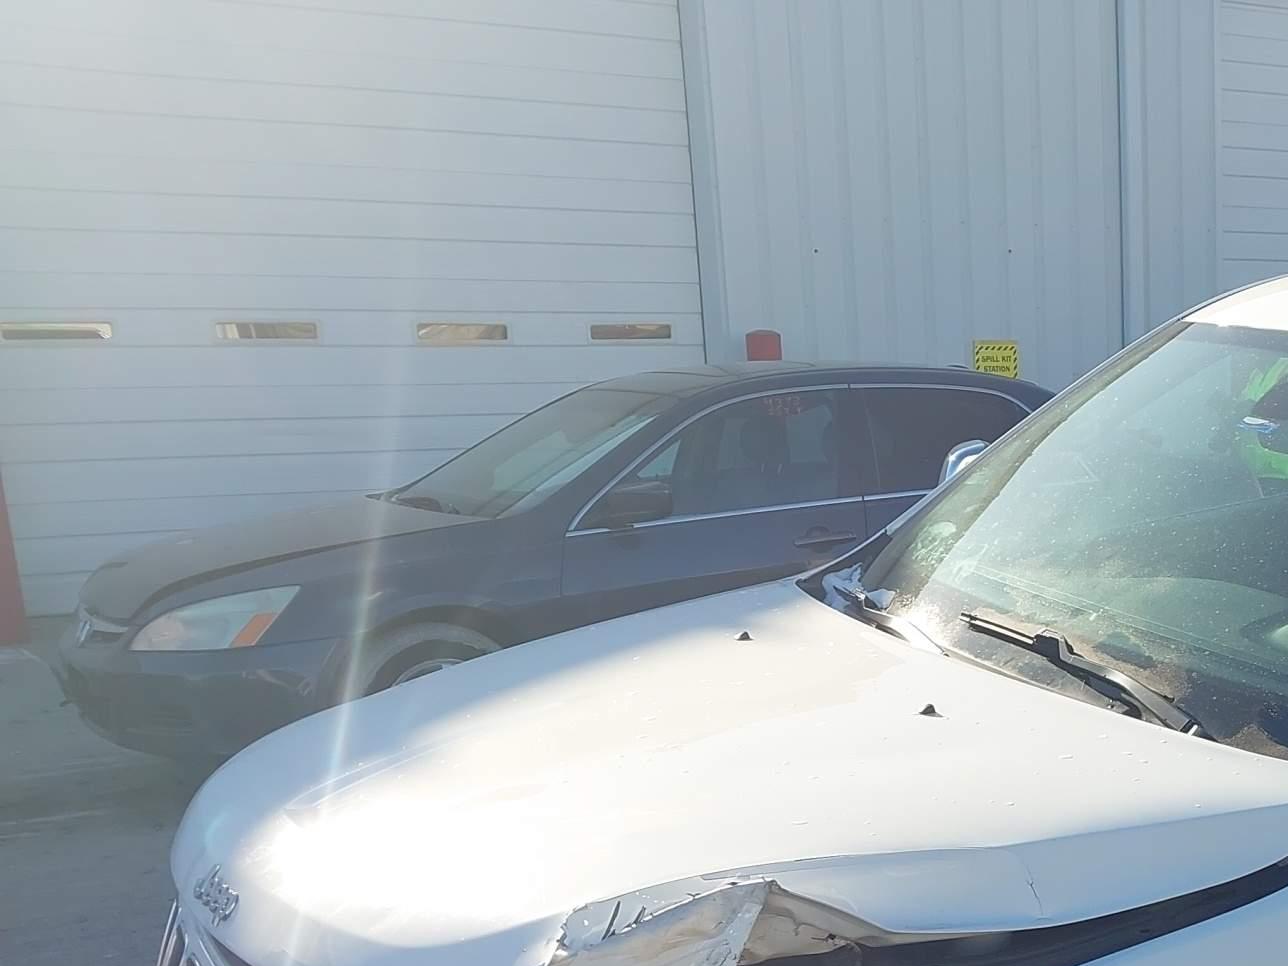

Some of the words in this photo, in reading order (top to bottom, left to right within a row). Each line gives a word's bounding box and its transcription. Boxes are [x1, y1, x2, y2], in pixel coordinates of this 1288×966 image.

[981, 355, 1000, 363] SPILL
[1001, 355, 1012, 363] KIT
[983, 365, 1011, 373] STATION
